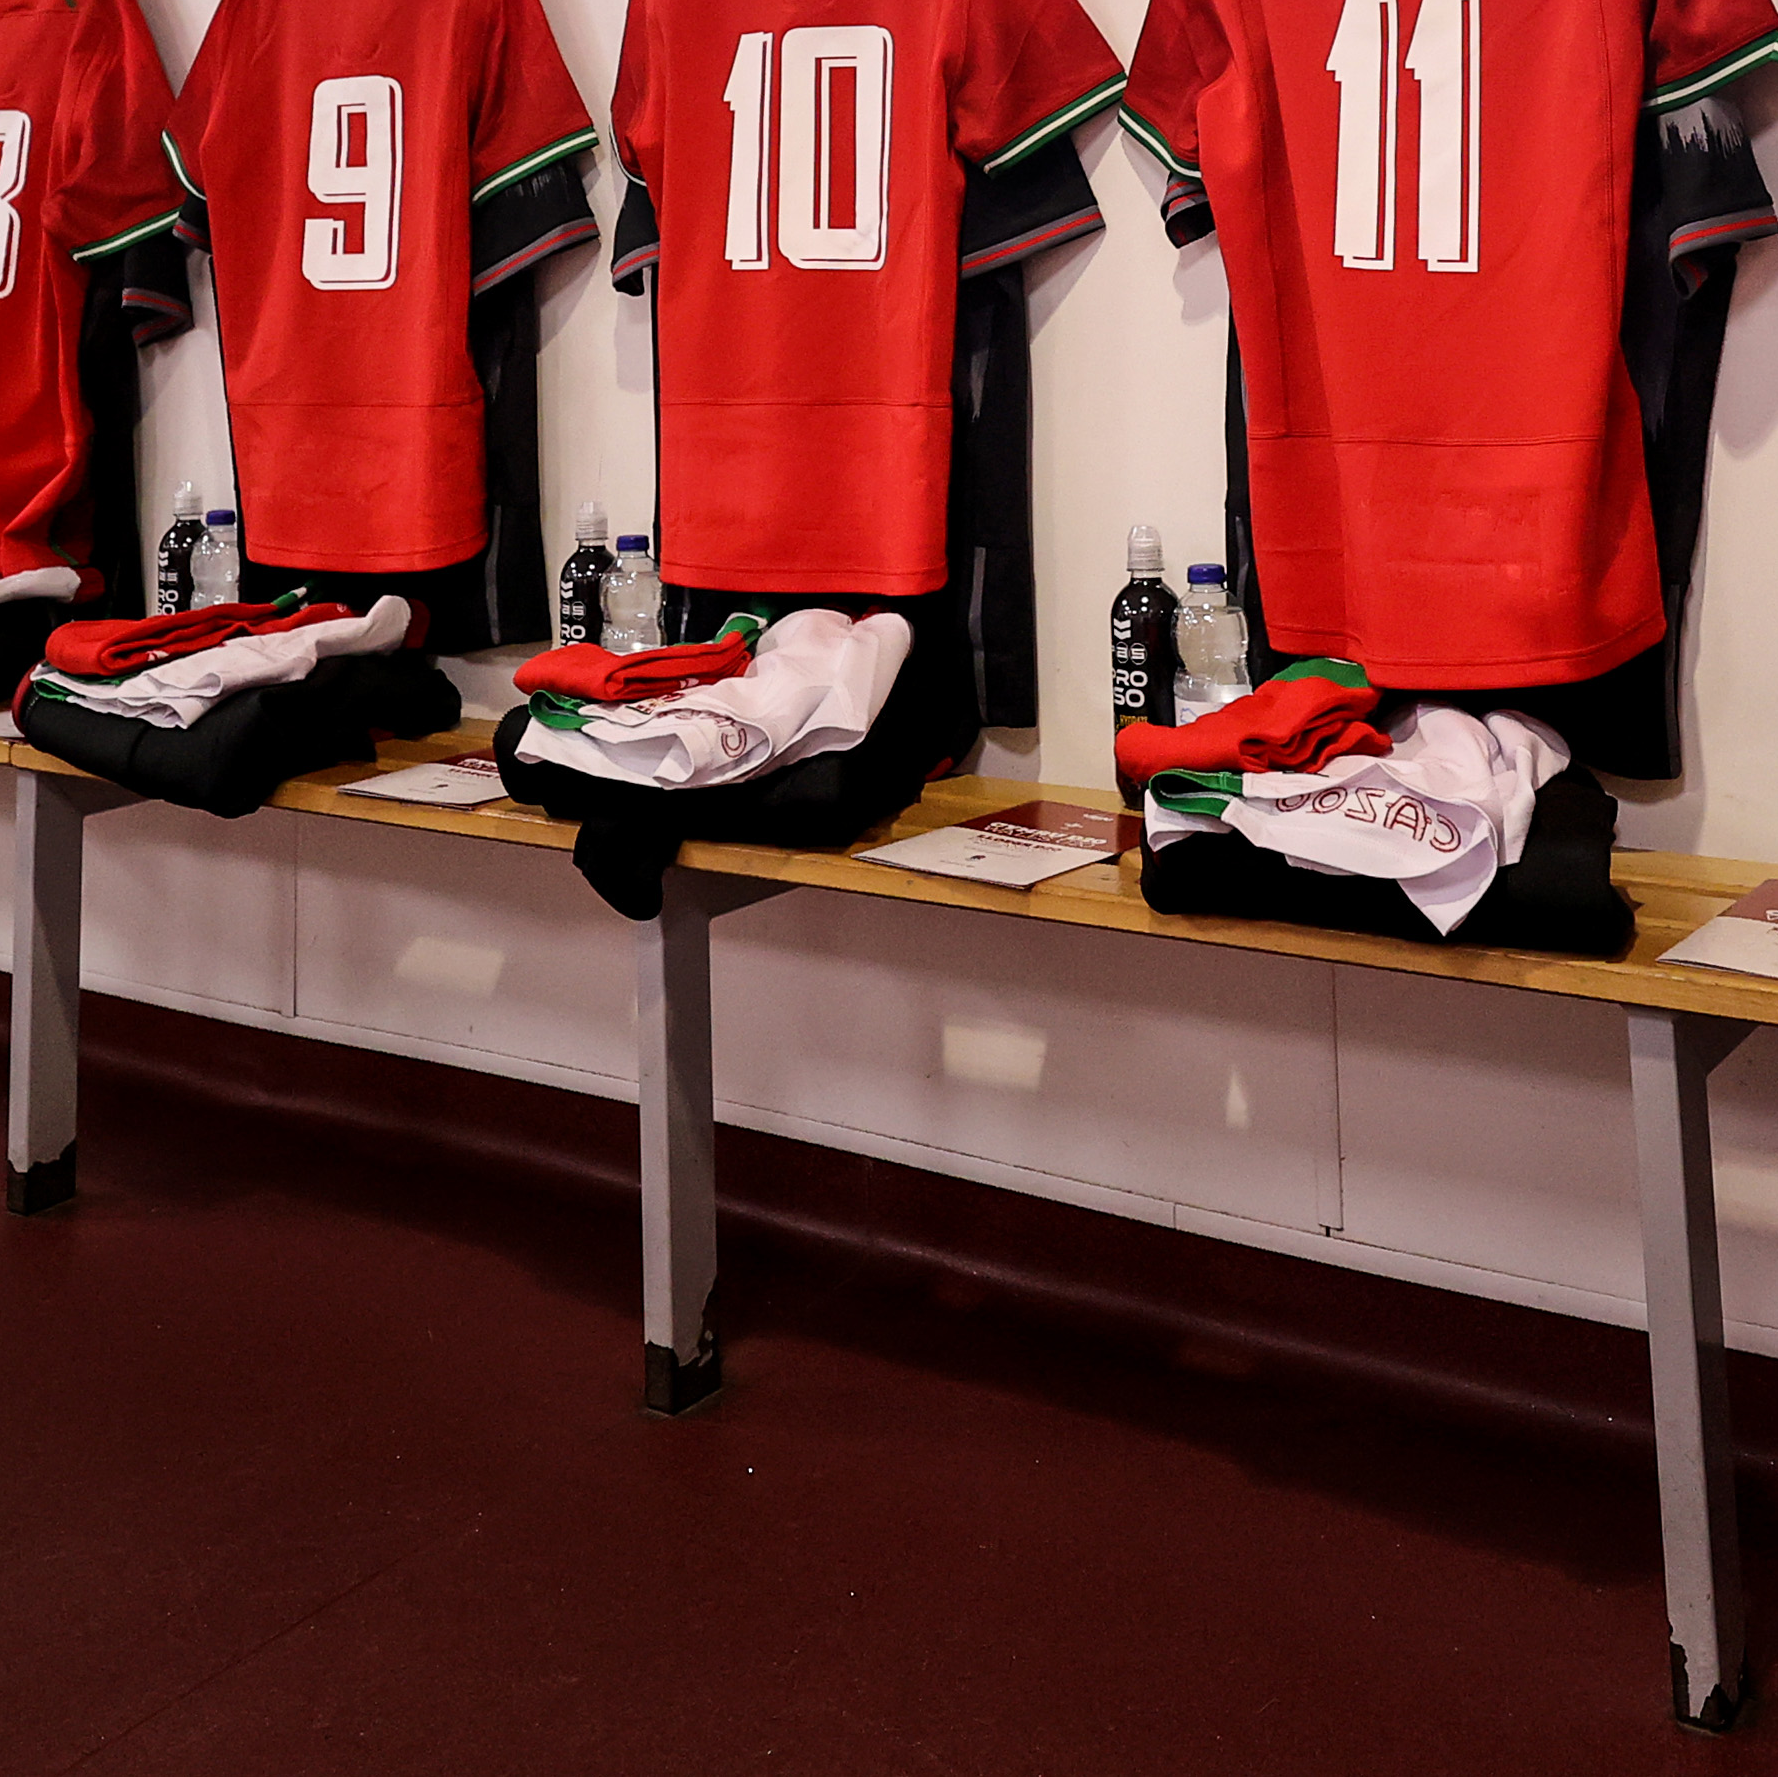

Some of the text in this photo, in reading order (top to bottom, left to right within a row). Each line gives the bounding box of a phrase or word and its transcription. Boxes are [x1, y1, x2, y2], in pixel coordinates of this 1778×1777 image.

[302, 75, 404, 290] 9
[723, 25, 894, 271] 10
[561, 624, 586, 639] RO
[1114, 686, 1145, 708] SO
